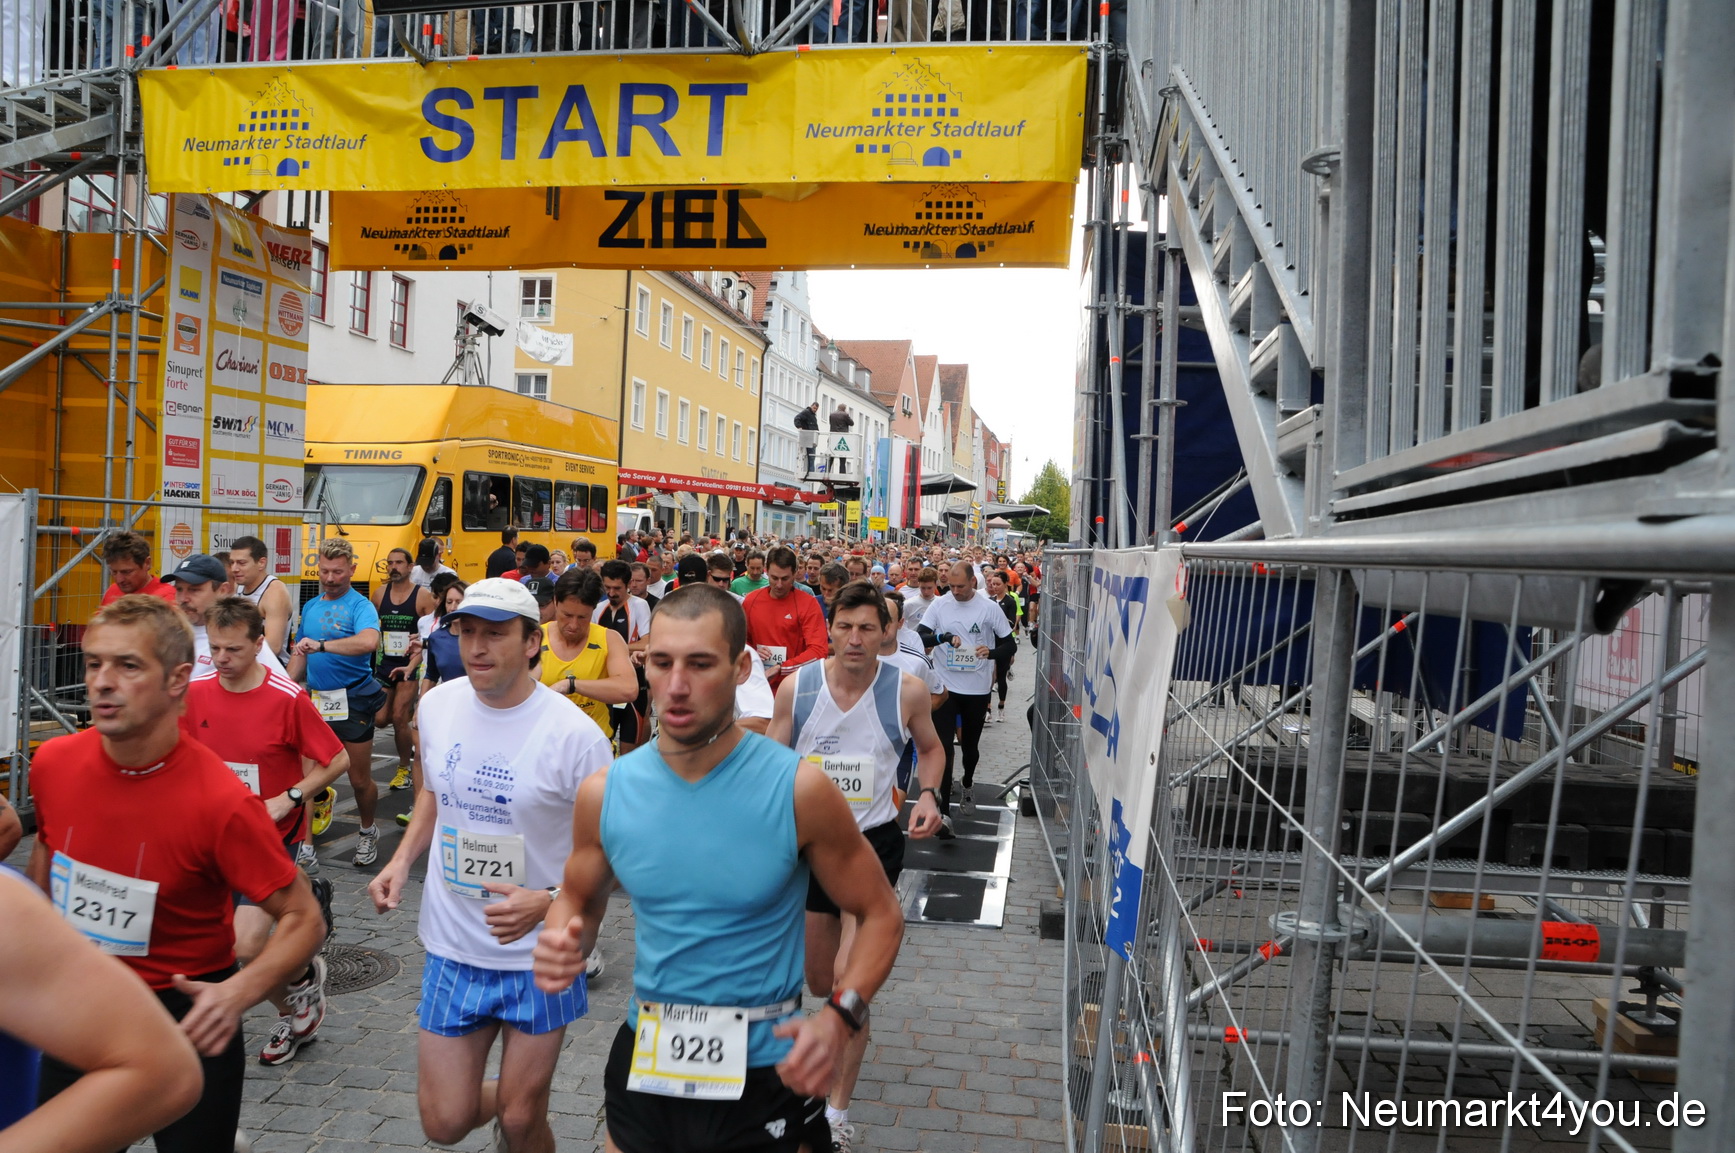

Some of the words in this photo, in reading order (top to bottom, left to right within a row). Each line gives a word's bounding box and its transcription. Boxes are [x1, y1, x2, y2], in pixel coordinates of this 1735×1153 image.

[419, 83, 748, 163] START
[805, 120, 926, 139] Neumarkter
[930, 119, 1027, 138] Stadtlauf
[183, 135, 281, 152] Neumarkter
[283, 133, 368, 150] Stadtlauf
[598, 189, 768, 249] ZIEL
[360, 225, 443, 240] Neumarkter
[444, 225, 511, 239] Stadtlauf
[863, 222, 958, 237] Neumarkter
[962, 220, 1036, 236] Stadtlauf
[266, 241, 312, 265] MERZ
[180, 288, 199, 300] KANN
[278, 309, 304, 322] WITTMANN
[167, 360, 203, 379] Sinupret
[269, 362, 308, 385] OBI
[166, 376, 189, 391] forte
[176, 401, 203, 413] Egner
[267, 419, 294, 437] MCM
[344, 449, 403, 460] TIMING
[488, 449, 520, 462] SPORTRONIC
[565, 462, 579, 473] EVENT
[578, 464, 595, 475] SERVICE
[169, 481, 200, 490] INTERSPORT
[265, 483, 289, 491] GERHART
[632, 472, 656, 482] Service
[669, 477, 685, 486] Miet-
[741, 485, 757, 493] 6352
[163, 488, 200, 499] HACKNER
[226, 489, 240, 497] MAX
[241, 487, 257, 498] BÖGL
[275, 490, 291, 498] JANIG
[997, 480, 1006, 504] HOT
[213, 533, 237, 549] Sinu
[392, 641, 403, 649] 33
[955, 654, 975, 663] 2755
[323, 701, 342, 711] 522
[824, 760, 861, 772] Gerhard
[473, 777, 516, 793] 16.09.2007
[441, 793, 454, 808] 8.
[455, 800, 511, 817] Neumarkter
[462, 837, 498, 854] Helmut
[463, 857, 514, 878] 2721
[75, 871, 129, 900] Manfred
[73, 896, 138, 929] 2317
[663, 1003, 709, 1024] Martin
[670, 1034, 725, 1064] 928
